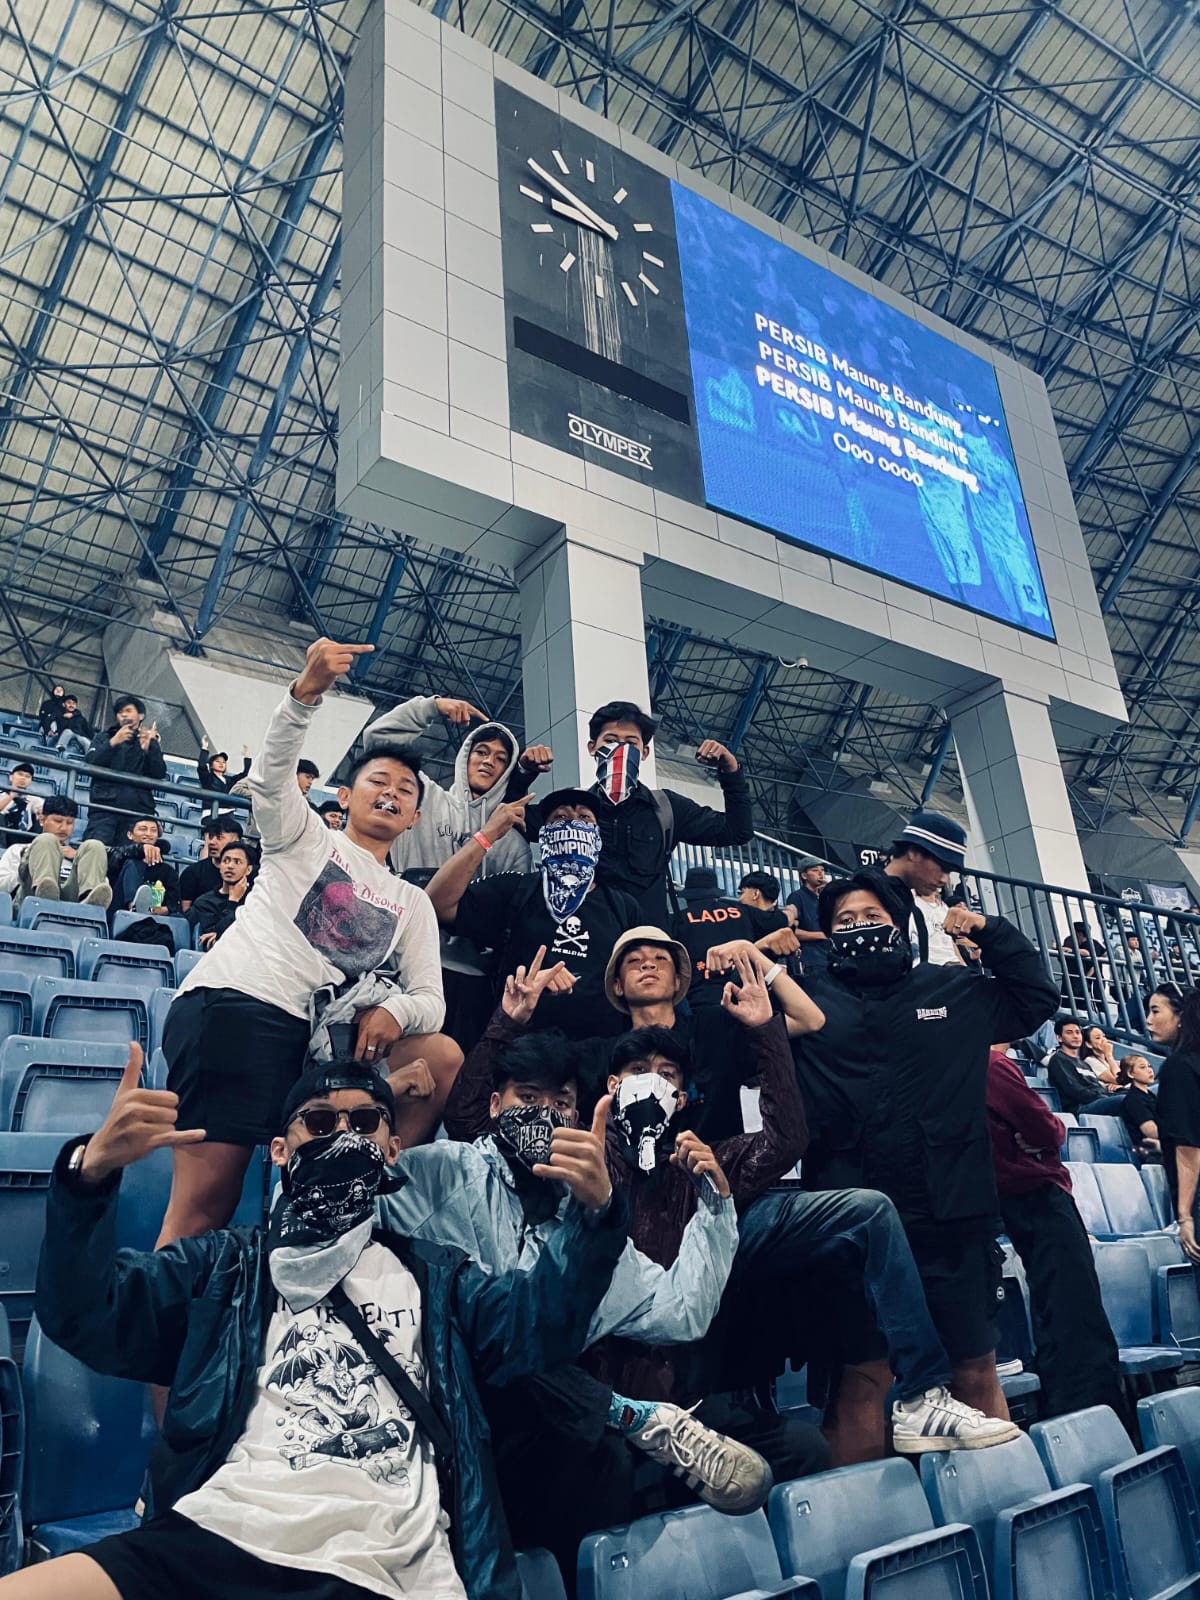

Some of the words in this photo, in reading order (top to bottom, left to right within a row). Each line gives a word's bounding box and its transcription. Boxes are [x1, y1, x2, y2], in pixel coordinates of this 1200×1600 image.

[754, 312, 828, 365] PERSIB
[832, 353, 892, 401] Maung
[893, 384, 964, 440] Bandung
[755, 365, 835, 420] PERSIB
[838, 406, 903, 457] Maung
[758, 341, 832, 393] PERSIB
[836, 381, 896, 429] Maung
[898, 411, 969, 465] Bandung
[568, 417, 651, 465] OLYMPEX
[833, 432, 875, 465] Ooo
[879, 456, 925, 487] oooo
[686, 906, 742, 923] LADS
